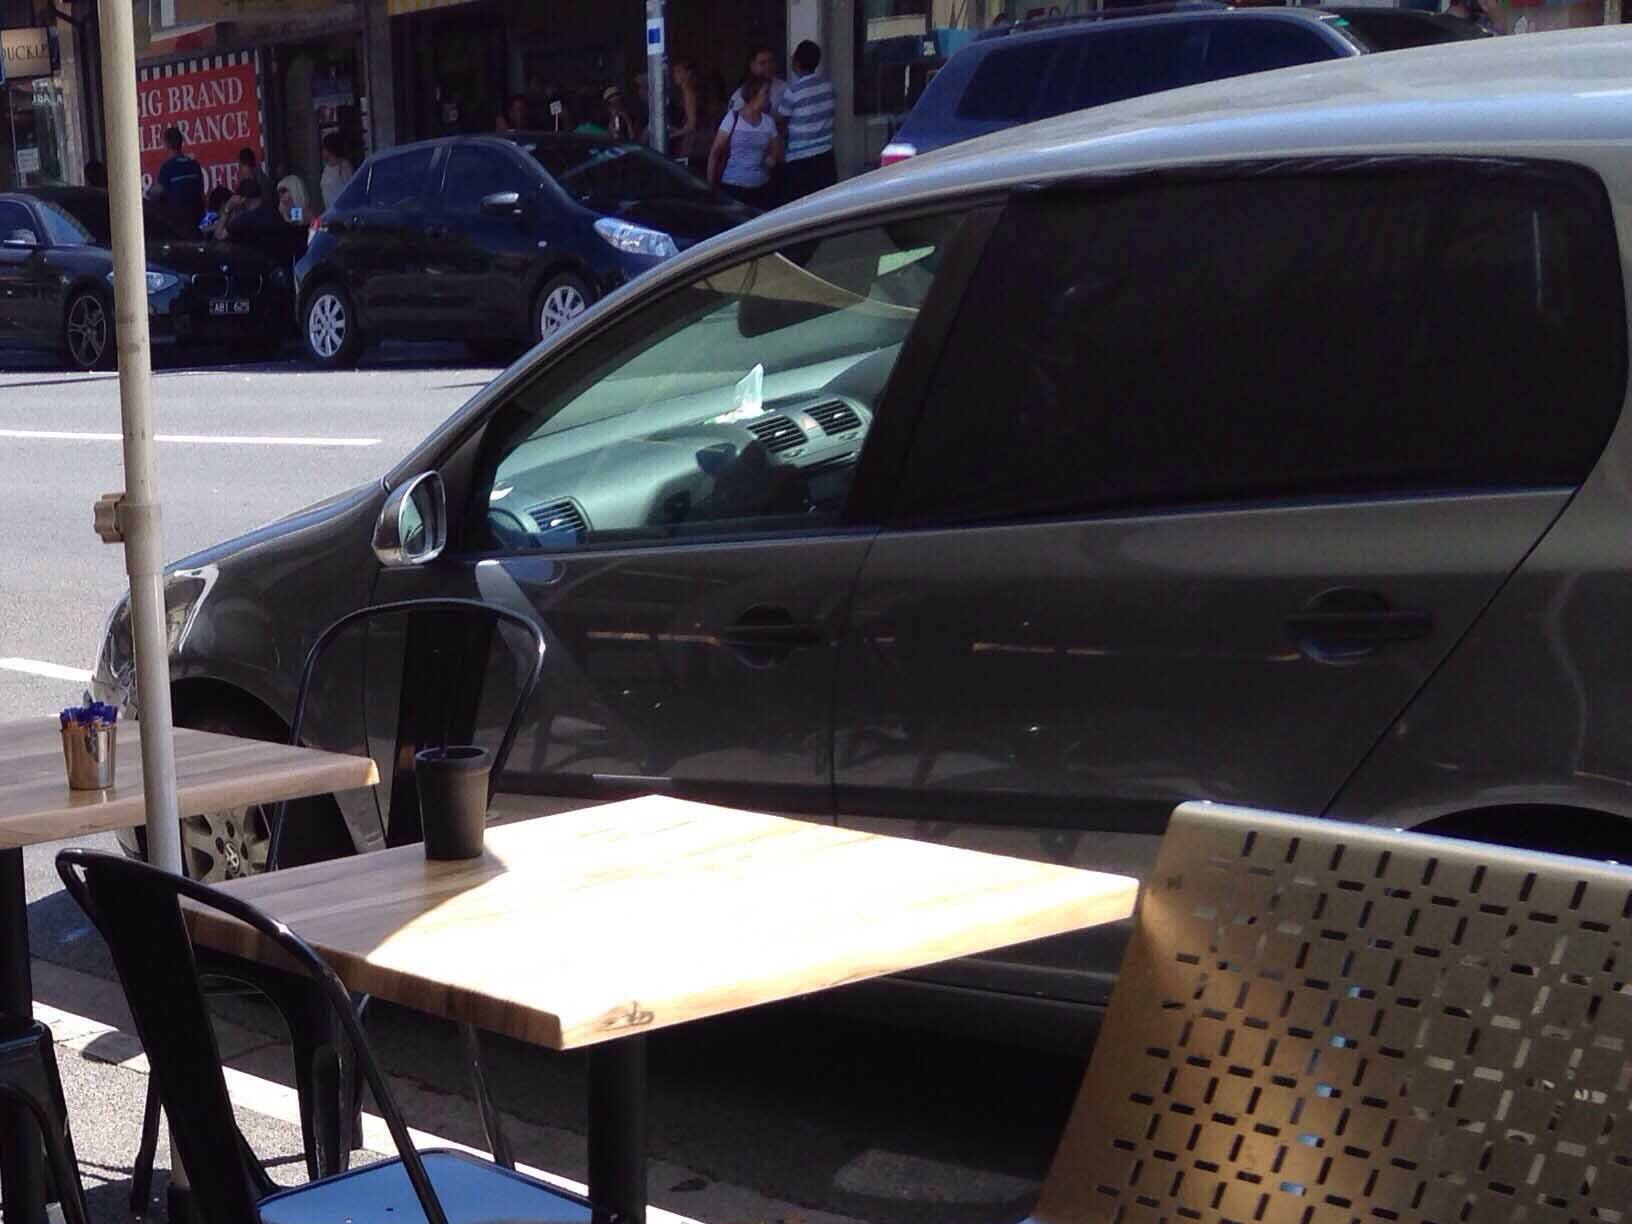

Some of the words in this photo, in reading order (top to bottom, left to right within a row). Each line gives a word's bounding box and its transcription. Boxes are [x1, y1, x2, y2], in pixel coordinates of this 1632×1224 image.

[138, 89, 163, 118] IG
[168, 77, 244, 113] BRAND
[138, 111, 251, 152] LERANCE
